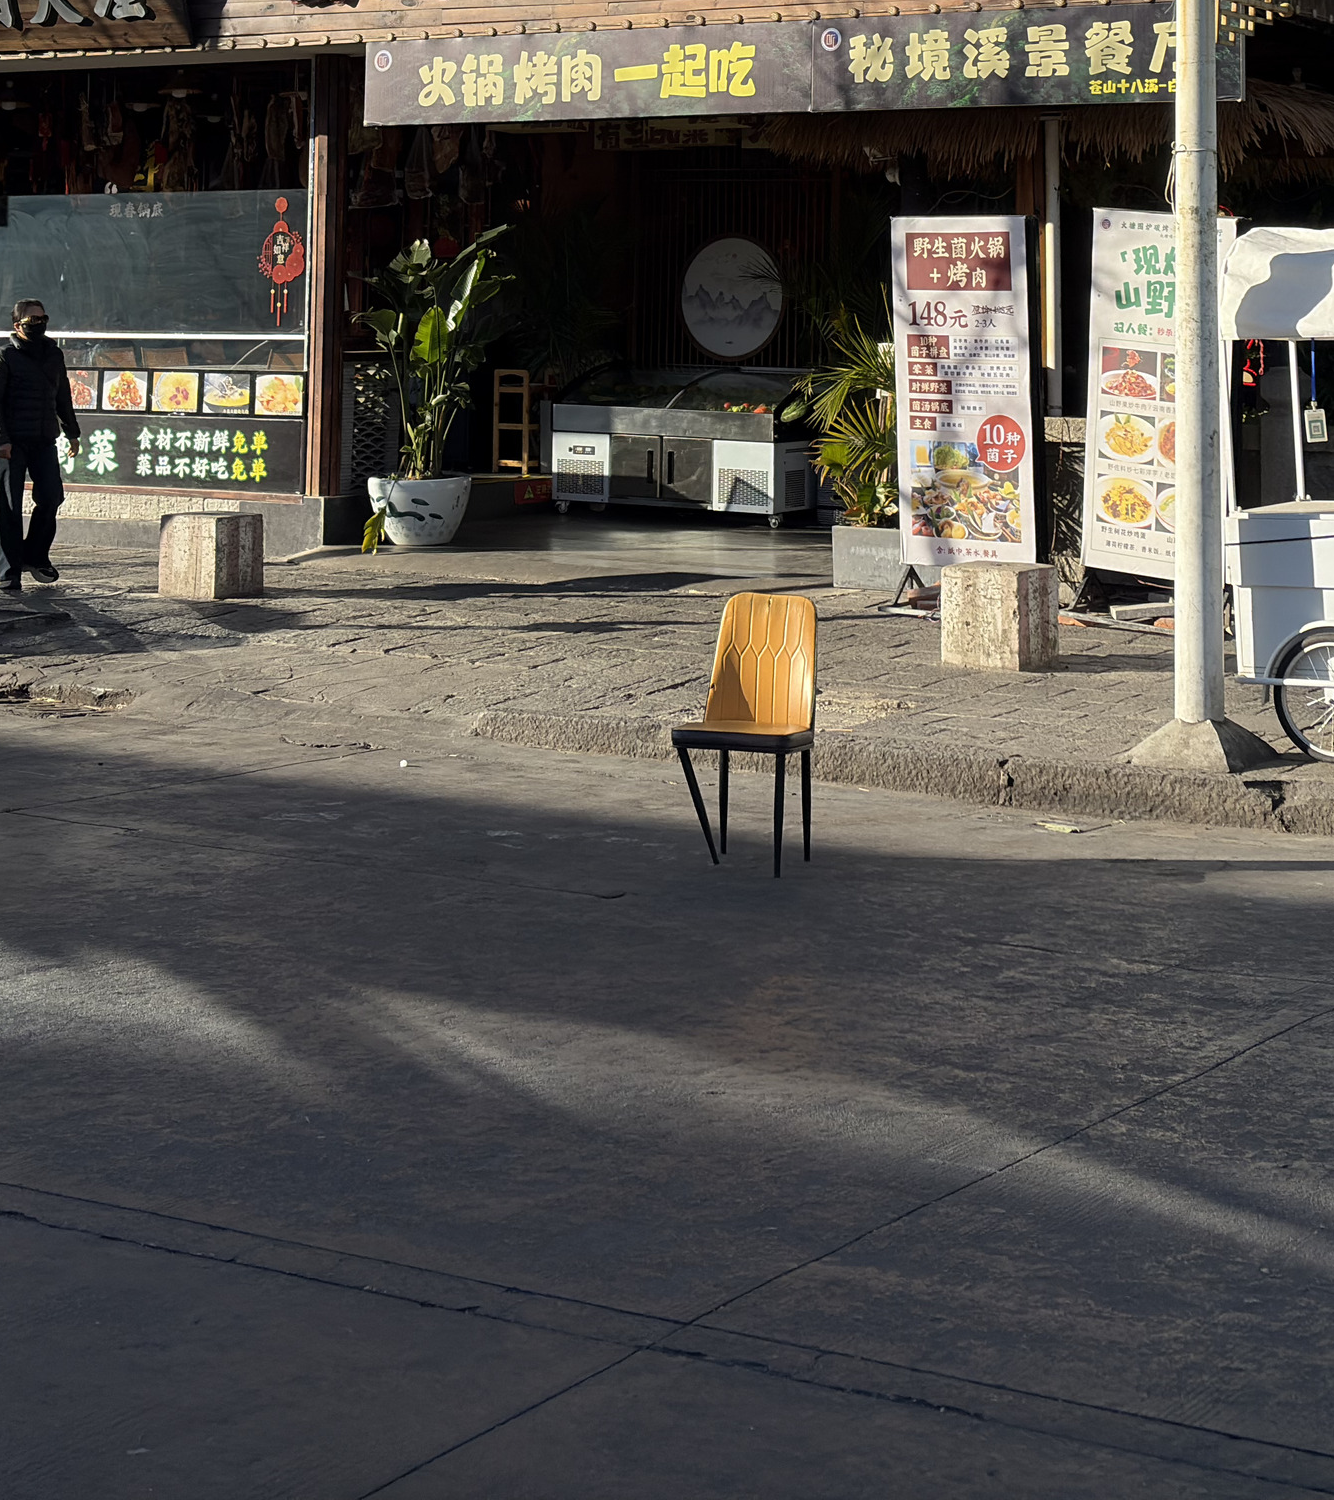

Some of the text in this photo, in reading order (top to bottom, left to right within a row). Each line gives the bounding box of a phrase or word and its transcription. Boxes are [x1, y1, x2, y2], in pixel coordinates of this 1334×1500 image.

[913, 236, 1005, 259] 野生菌火锅
[908, 300, 968, 328] 148元
[975, 319, 997, 328] 2-3人
[137, 427, 268, 455] 食材不新鲜免单
[982, 424, 1021, 447] 10种
[136, 455, 268, 480] 菜品不好吃免单
[987, 449, 1017, 464] 菌子
